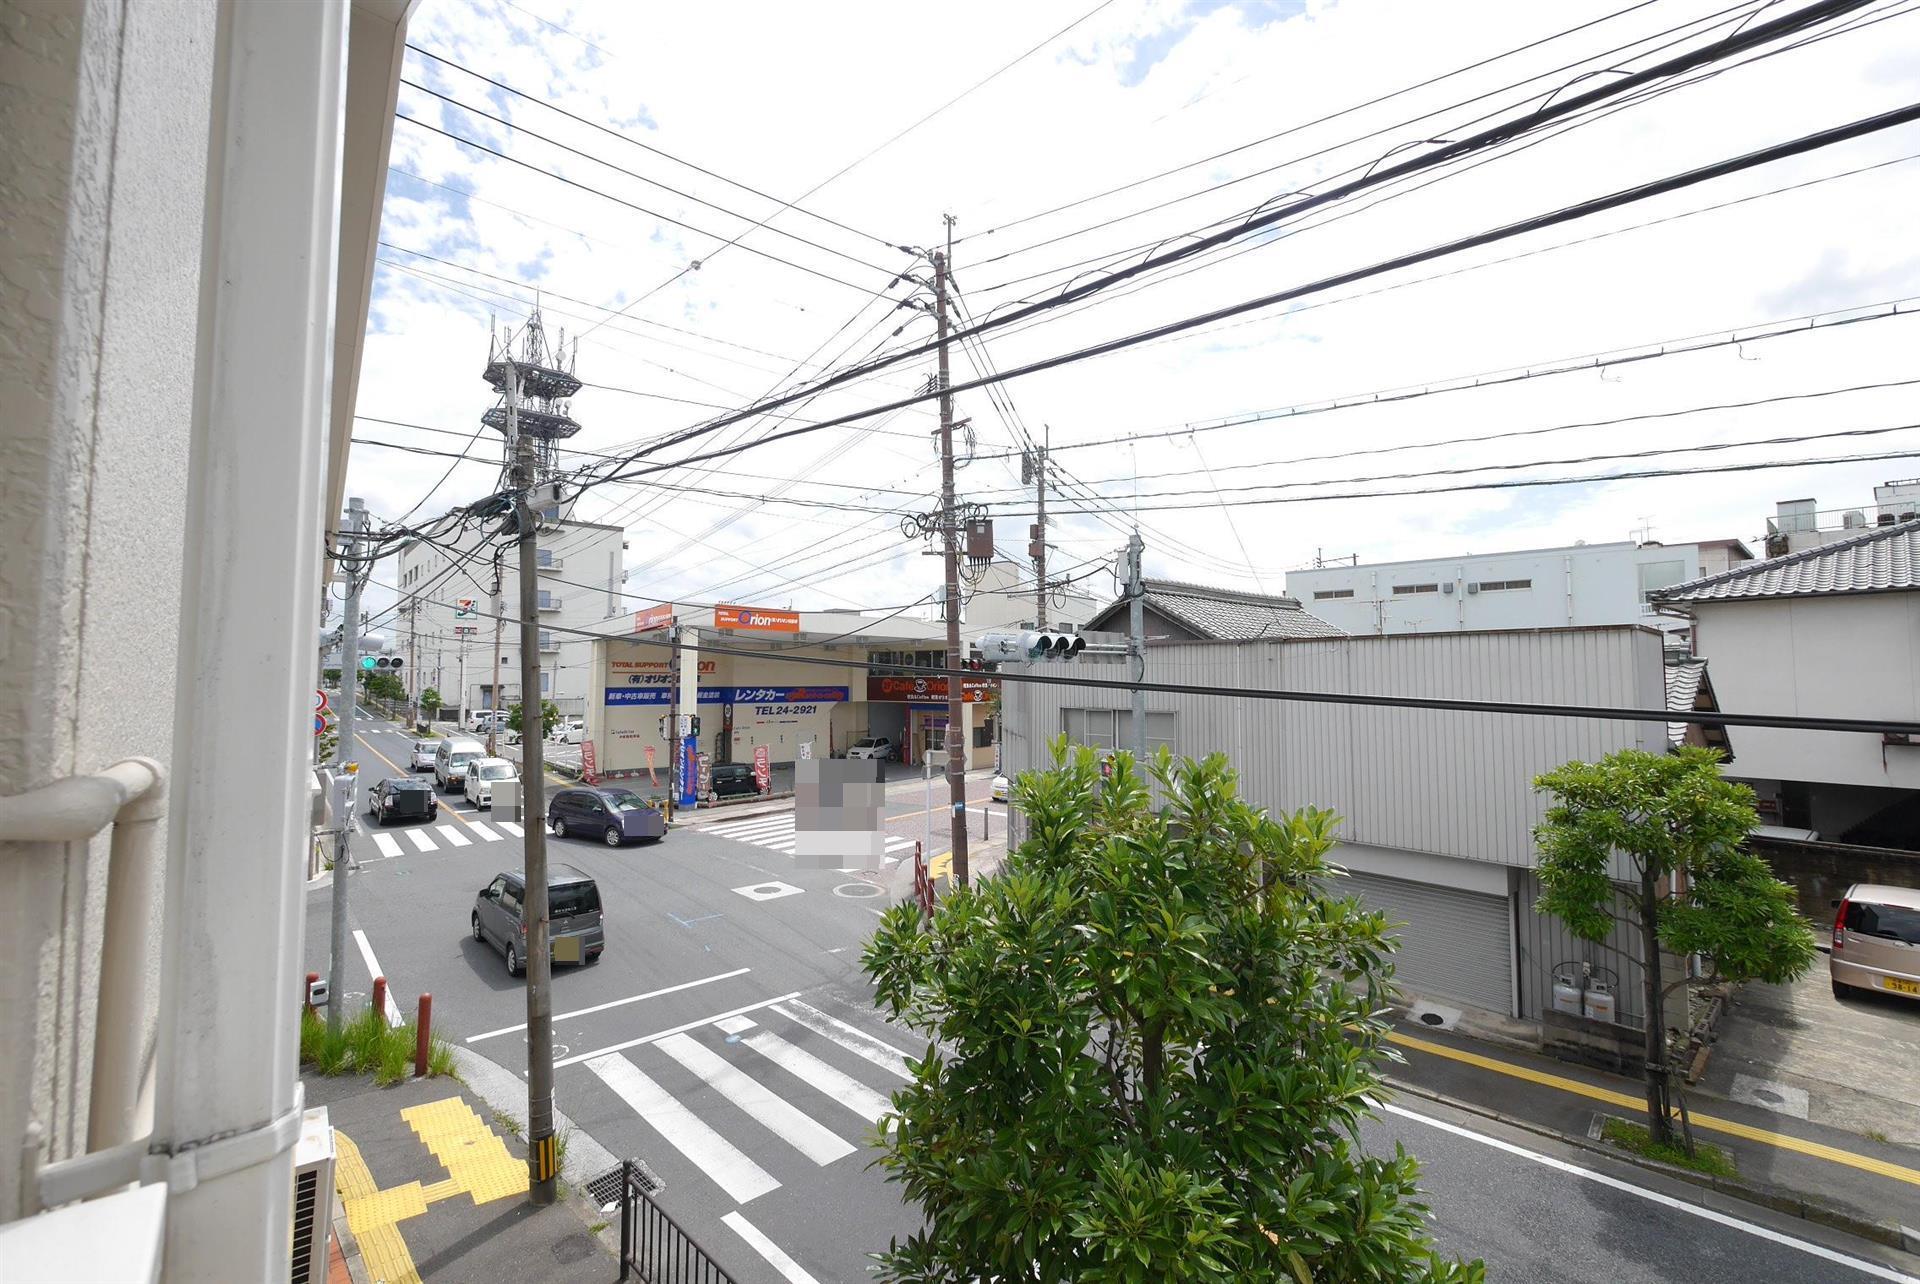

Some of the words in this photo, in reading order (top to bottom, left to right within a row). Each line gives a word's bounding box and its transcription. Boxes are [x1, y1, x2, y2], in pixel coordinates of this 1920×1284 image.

[739, 610, 771, 626] Orion
[735, 689, 785, 701] レンタカー
[755, 706, 776, 715] TEL
[776, 705, 817, 715] 24-2921
